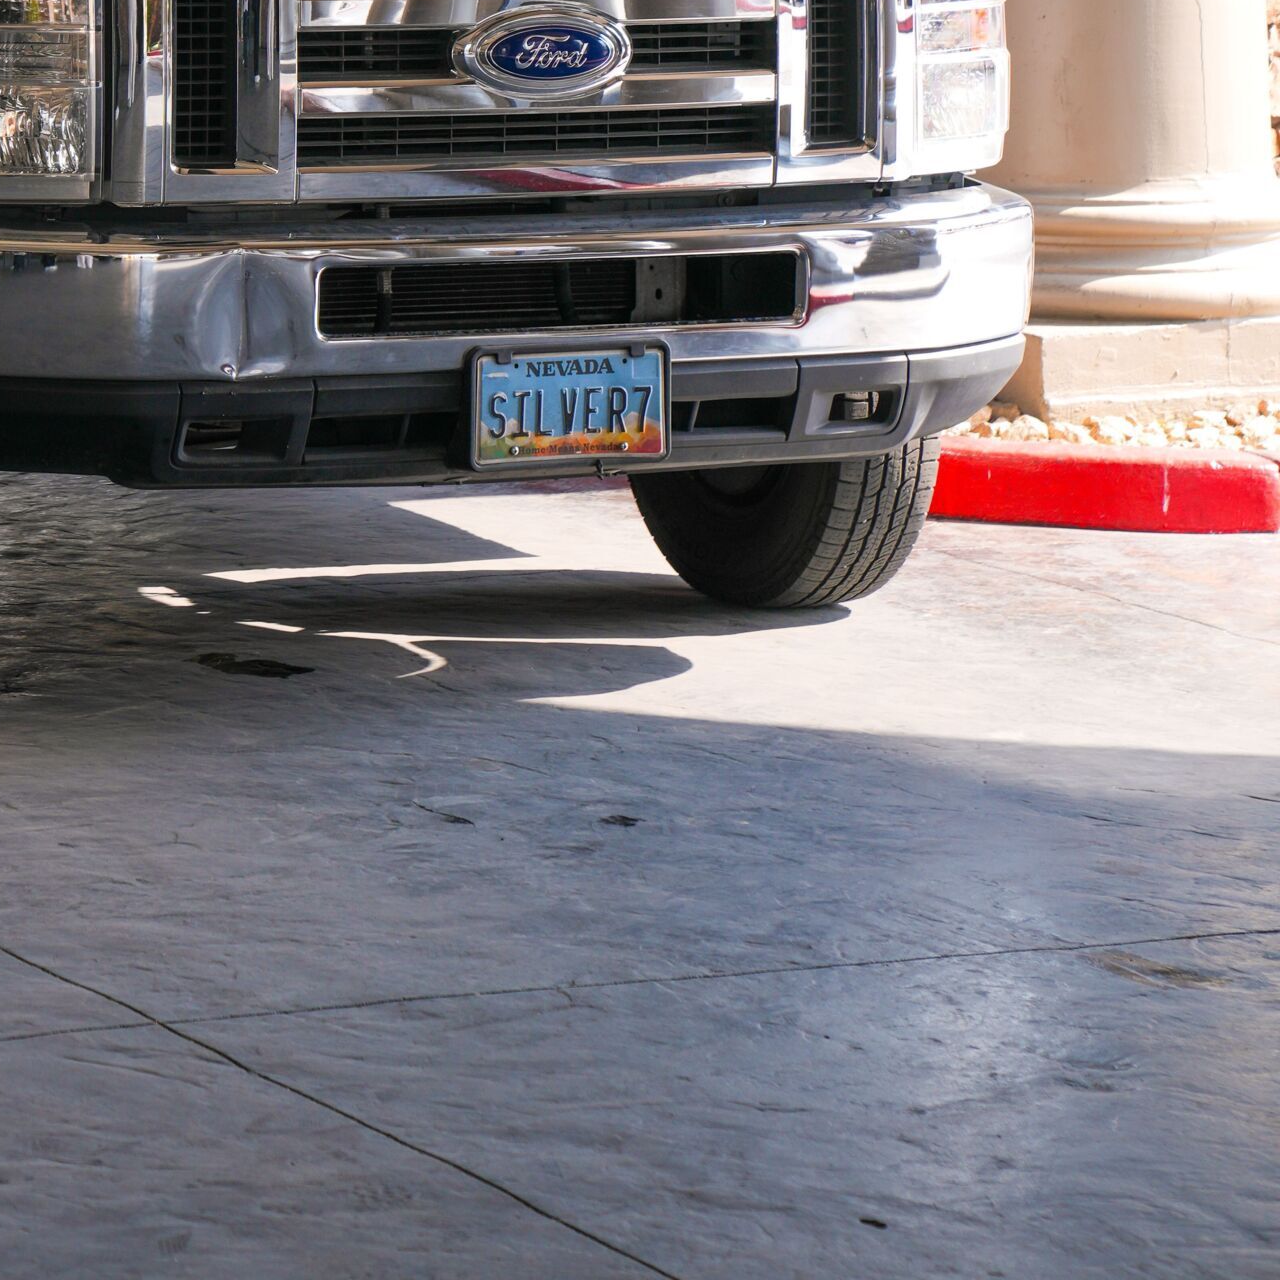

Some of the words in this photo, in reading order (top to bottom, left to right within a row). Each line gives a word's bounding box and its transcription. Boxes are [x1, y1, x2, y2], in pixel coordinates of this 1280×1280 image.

[515, 34, 589, 69] Ford
[526, 357, 615, 378] NEVADA
[489, 385, 653, 440] SILVER7
[519, 445, 545, 455] Home
[549, 443, 580, 454] Means
[583, 441, 619, 452] Nevada
